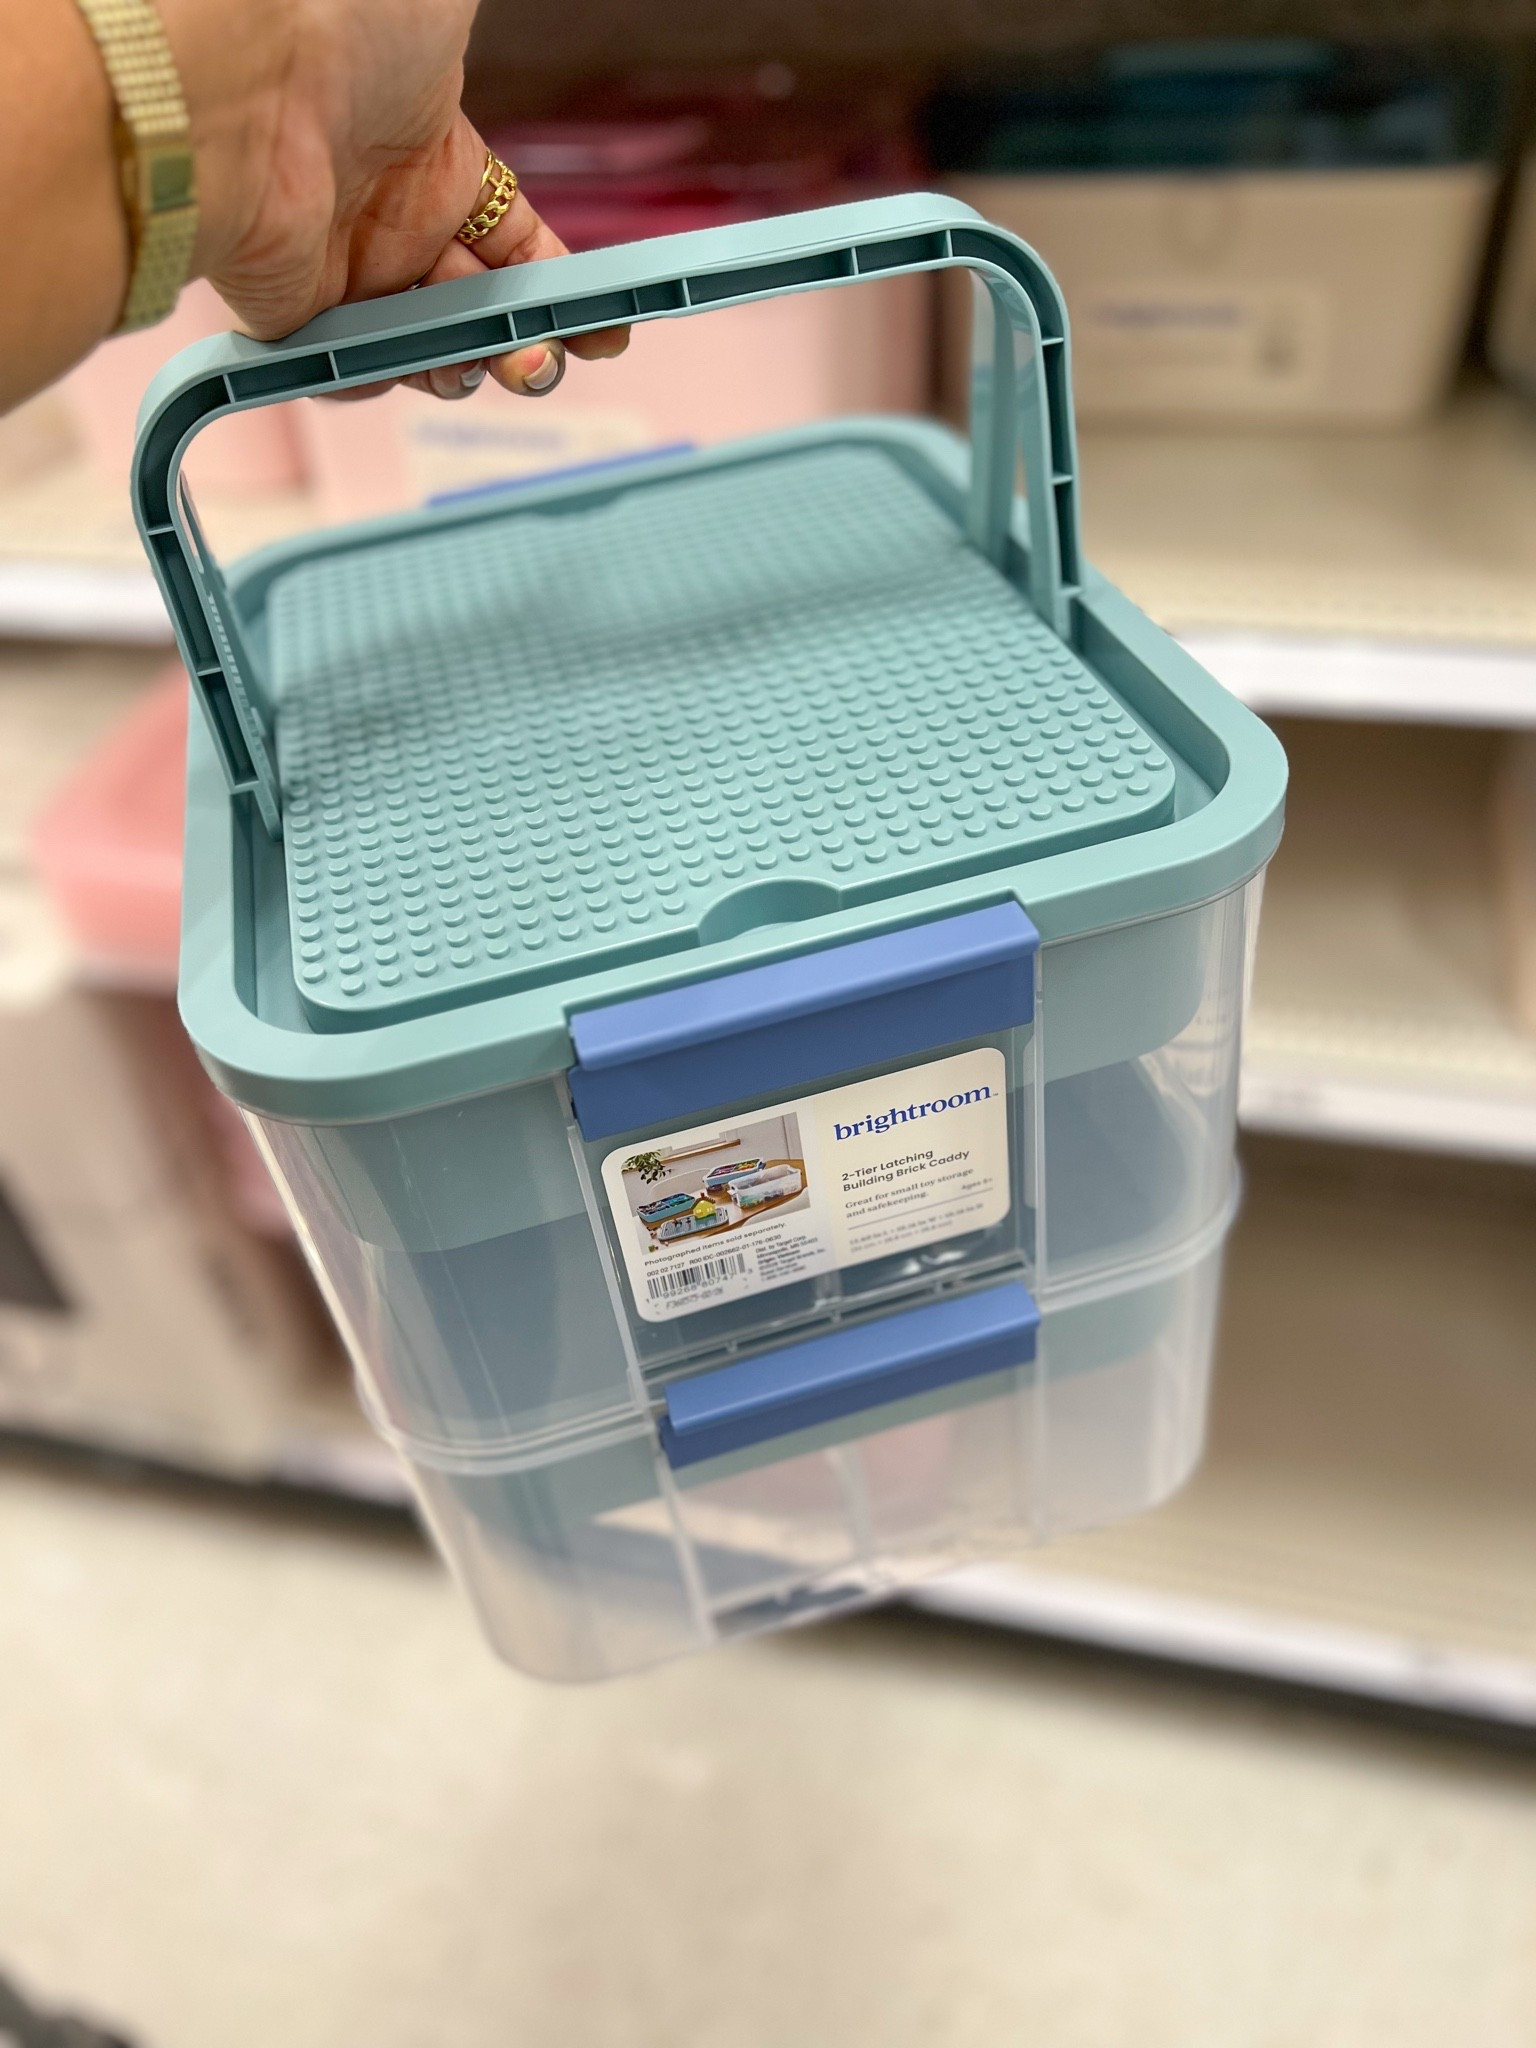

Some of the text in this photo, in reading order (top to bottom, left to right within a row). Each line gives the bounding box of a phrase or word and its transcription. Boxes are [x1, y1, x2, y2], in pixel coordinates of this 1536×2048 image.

[833, 1086, 991, 1141] brightroom
[842, 1150, 934, 1182] 2-Tier Latching
[843, 1151, 970, 1192] Building Brick Caddy
[845, 1168, 974, 1209] Great for small toy storage
[846, 1191, 929, 1218] and safekeeping.
[644, 1247, 701, 1266] Photographed
[702, 1240, 724, 1251] items
[726, 1235, 742, 1244] sold
[646, 1269, 660, 1277] 002
[670, 1262, 685, 1271] 7127
[662, 1284, 698, 1299] 99268
[701, 1273, 735, 1288] 80747
